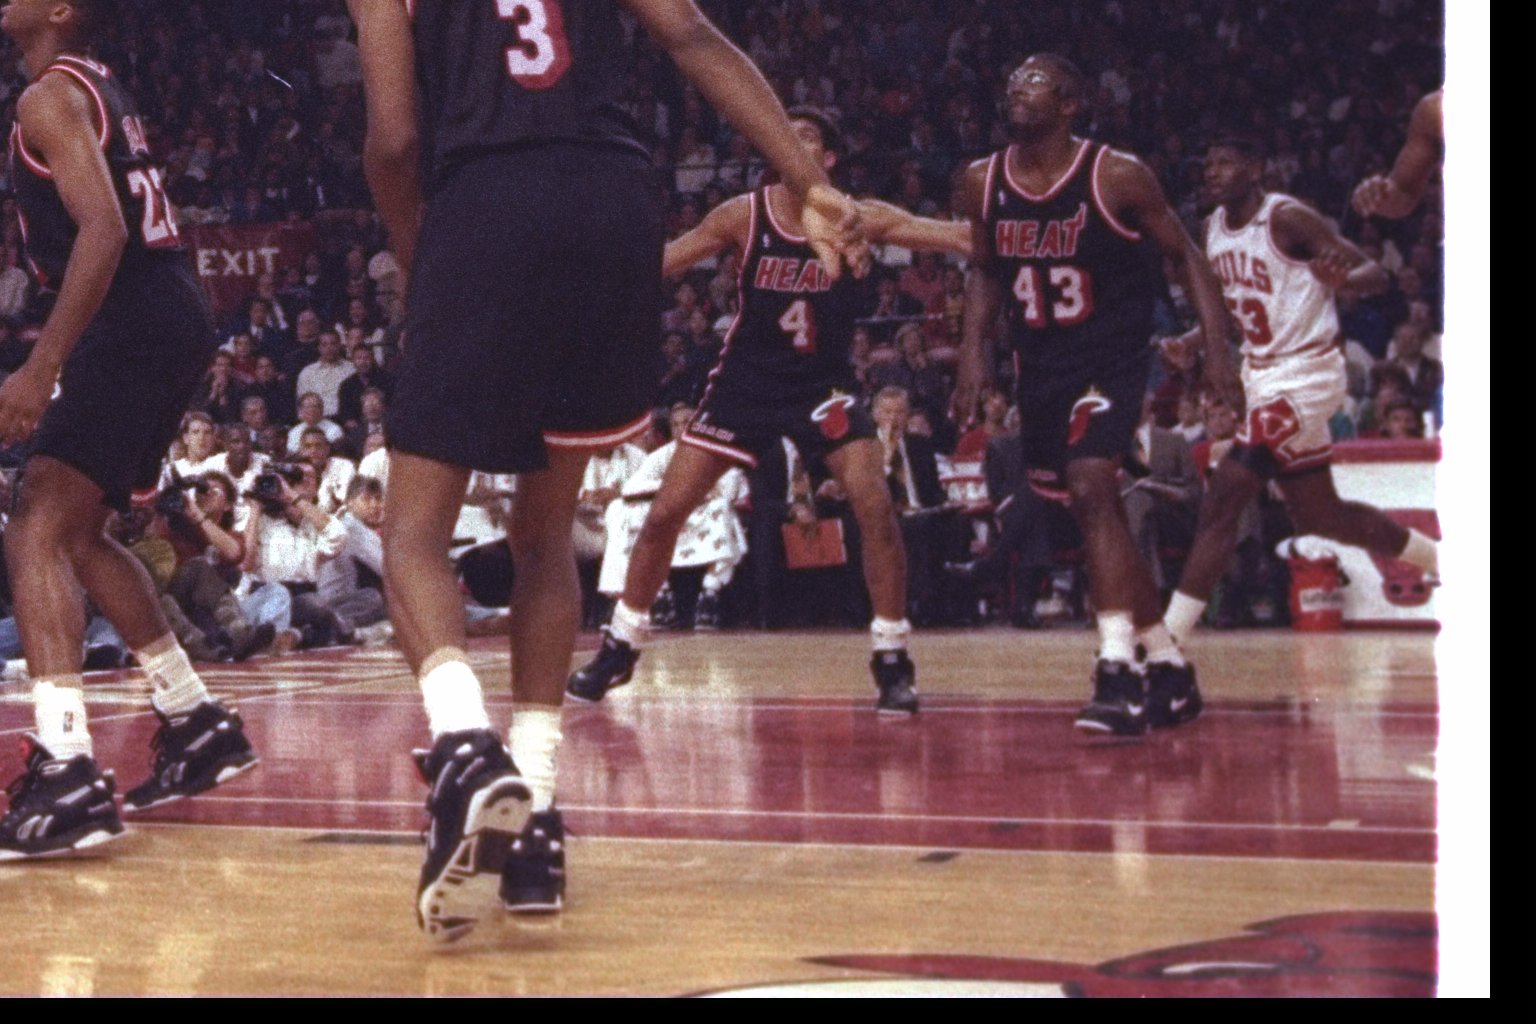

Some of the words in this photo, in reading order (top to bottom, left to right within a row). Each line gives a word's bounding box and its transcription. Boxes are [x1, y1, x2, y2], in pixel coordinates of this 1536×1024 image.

[995, 202, 1087, 258] HEAT
[197, 246, 281, 277] EXIT
[1012, 266, 1094, 328] 43
[778, 299, 817, 354] 4
